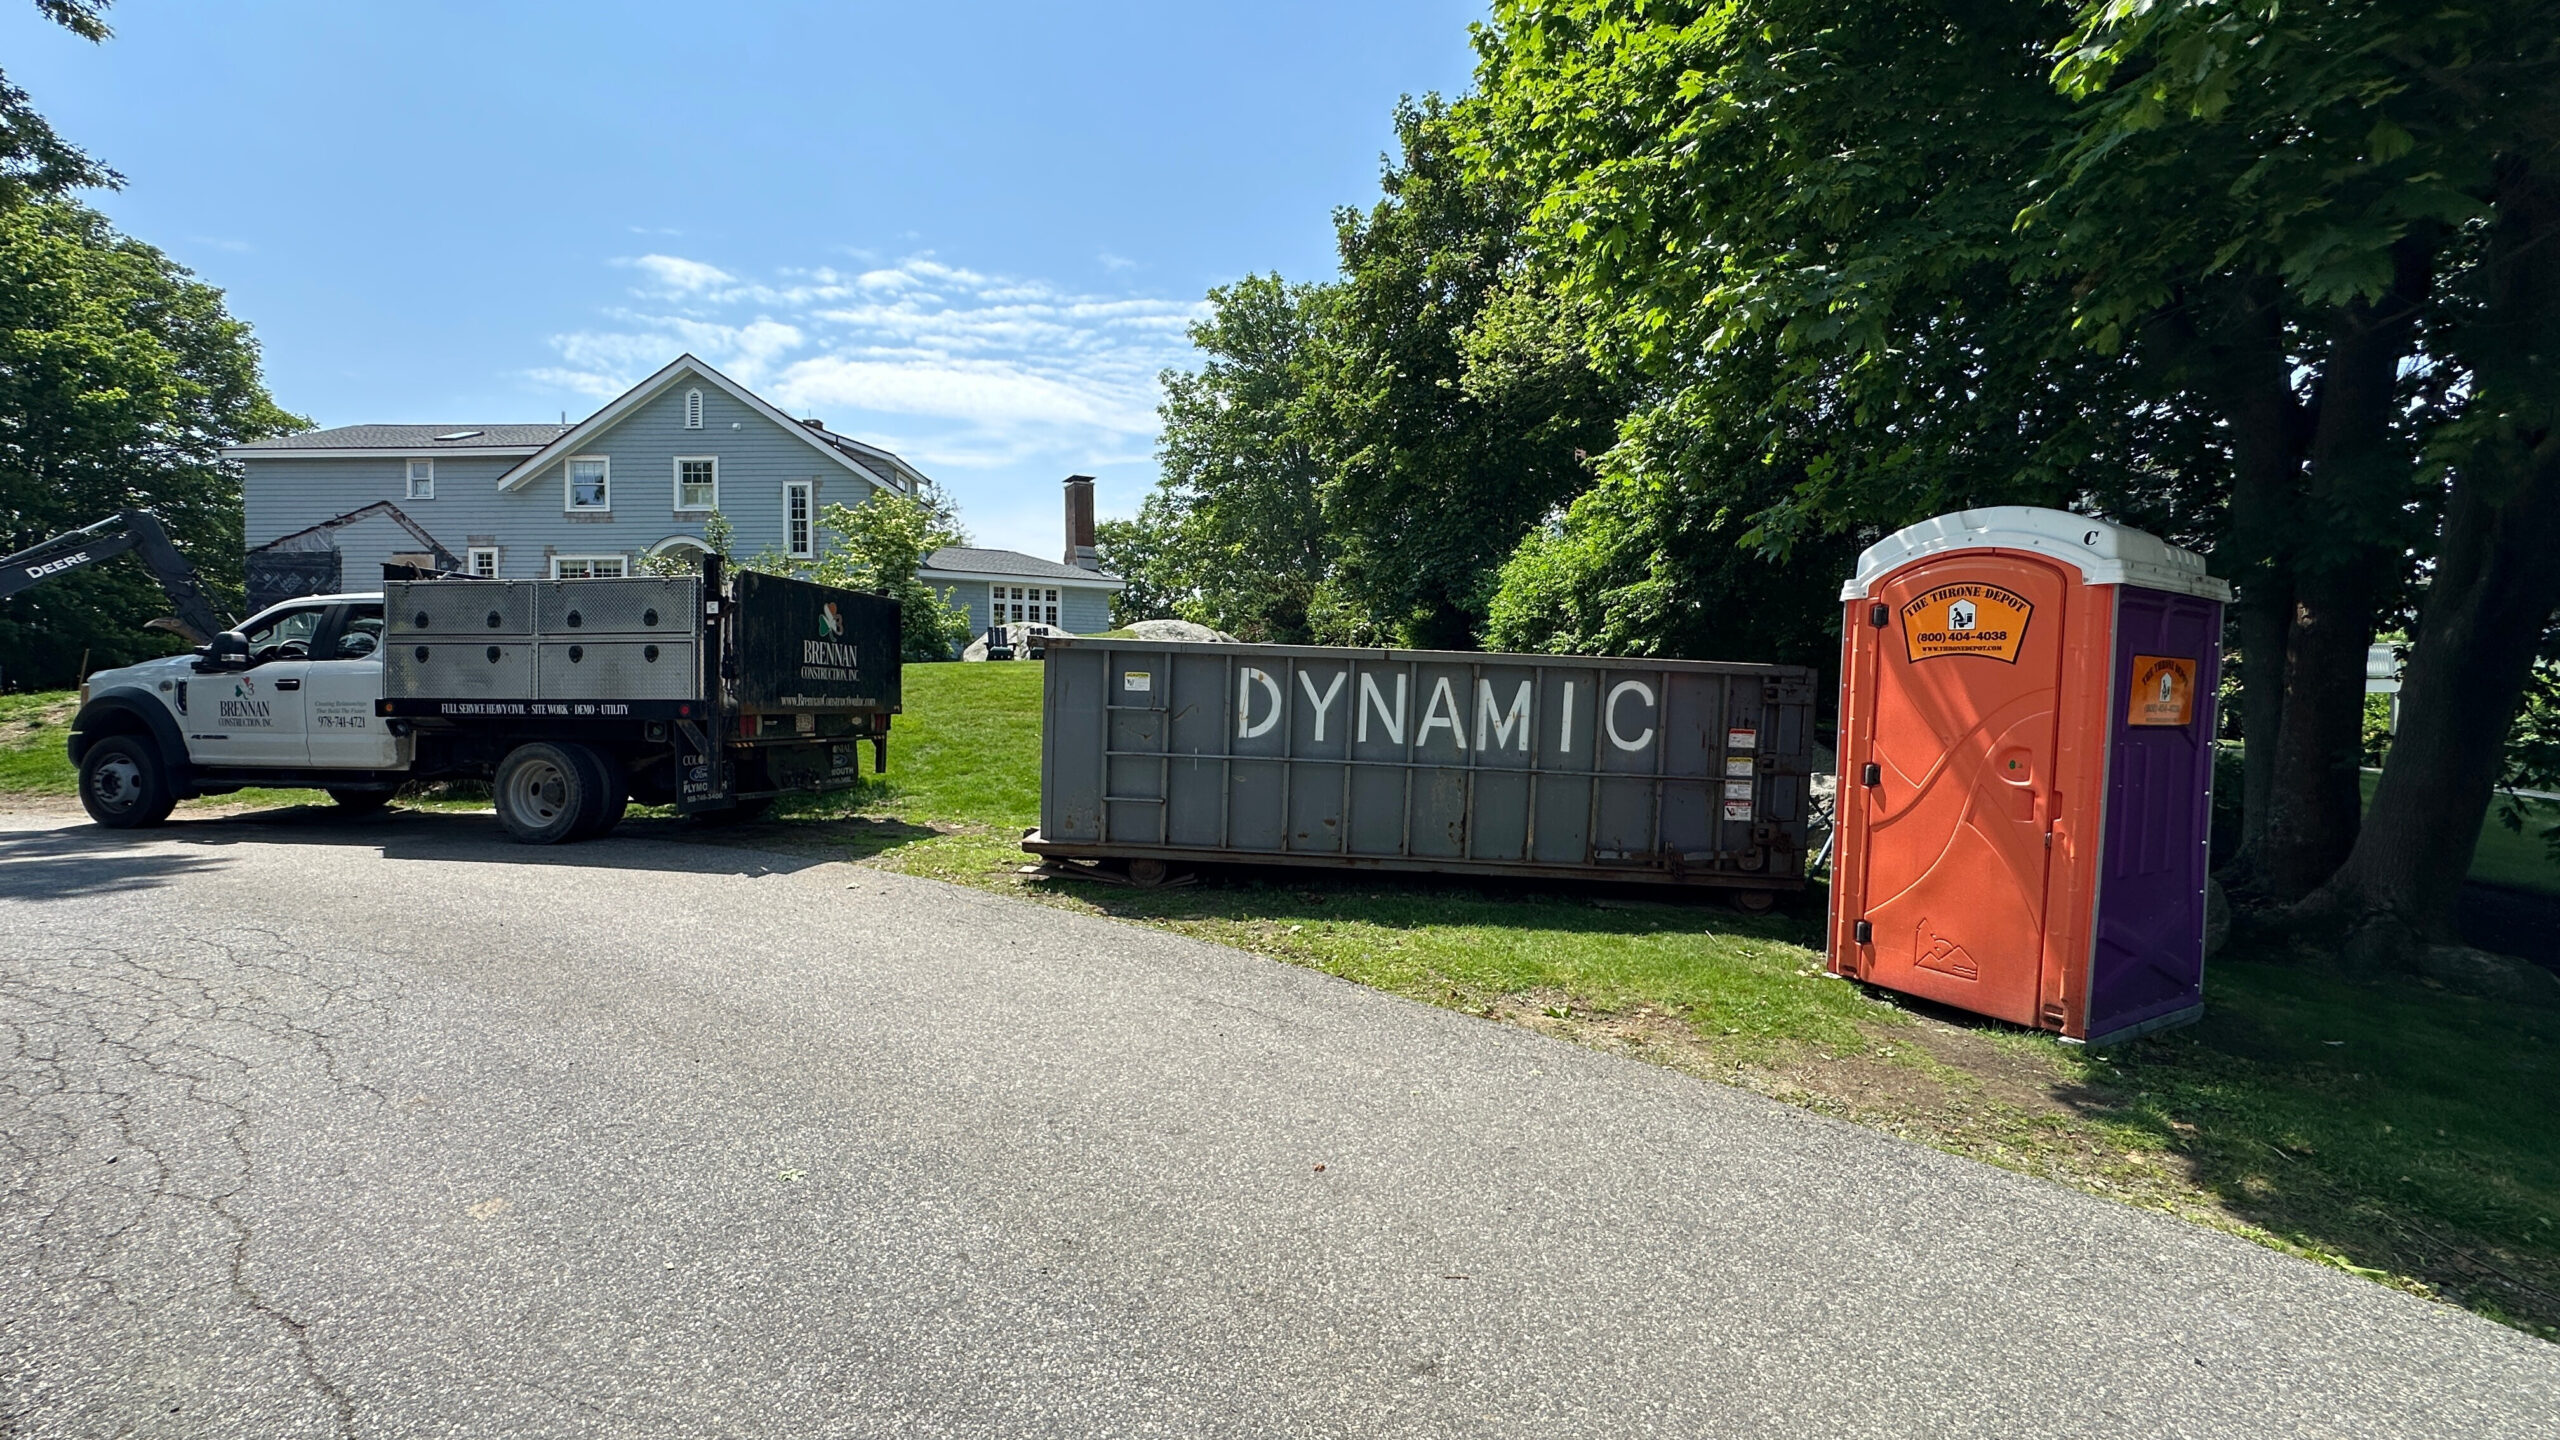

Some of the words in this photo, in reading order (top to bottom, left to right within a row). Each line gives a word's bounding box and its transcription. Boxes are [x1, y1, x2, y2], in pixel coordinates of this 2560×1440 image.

[2084, 531, 2099, 546] C
[25, 551, 91, 579] DEERE
[1905, 598, 1930, 617] THE
[1930, 586, 1982, 603] THRONE
[1984, 588, 2026, 613] DEPOT
[1917, 632, 1946, 644] (800)
[1948, 631, 2007, 642] 404-4038
[803, 639, 857, 668] BRENNAN
[220, 700, 270, 717] BRENNAN
[441, 703, 457, 714] FULL
[458, 703, 486, 714] SERVICE
[486, 703, 507, 715] HEAVY
[507, 704, 526, 715] CIVIL
[531, 704, 547, 715] SITE
[547, 704, 568, 715] WORK
[574, 704, 595, 715] DEMO
[601, 704, 629, 715] UTILITY
[1238, 667, 1654, 753] DYNAMIC
[318, 715, 366, 728] 978-741-4721
